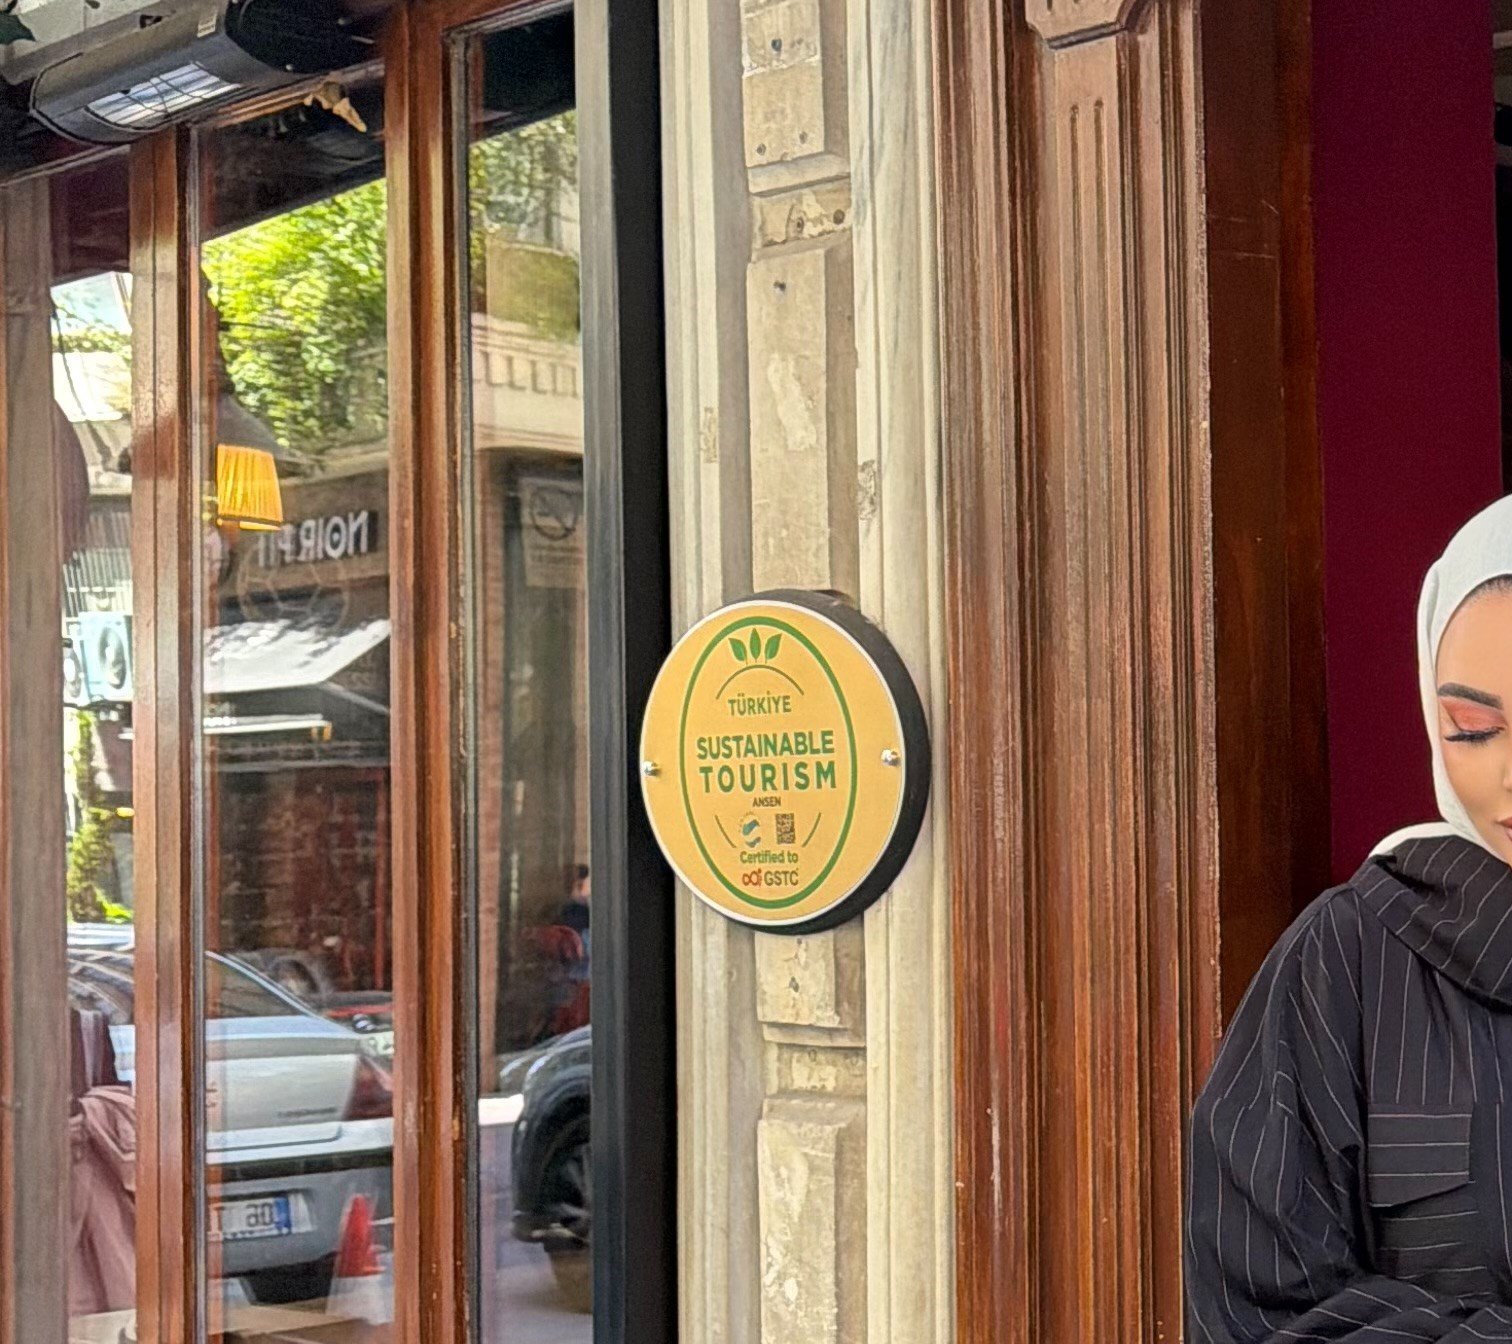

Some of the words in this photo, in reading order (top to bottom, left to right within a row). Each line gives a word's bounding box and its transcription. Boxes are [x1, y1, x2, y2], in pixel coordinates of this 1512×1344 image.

[728, 690, 792, 716] TÜRKİYE
[697, 730, 835, 760] SUSTAINABLE
[699, 760, 837, 793] TOURISM
[740, 850, 785, 864] Certified
[787, 850, 799, 864] to
[764, 870, 799, 887] GSTC
